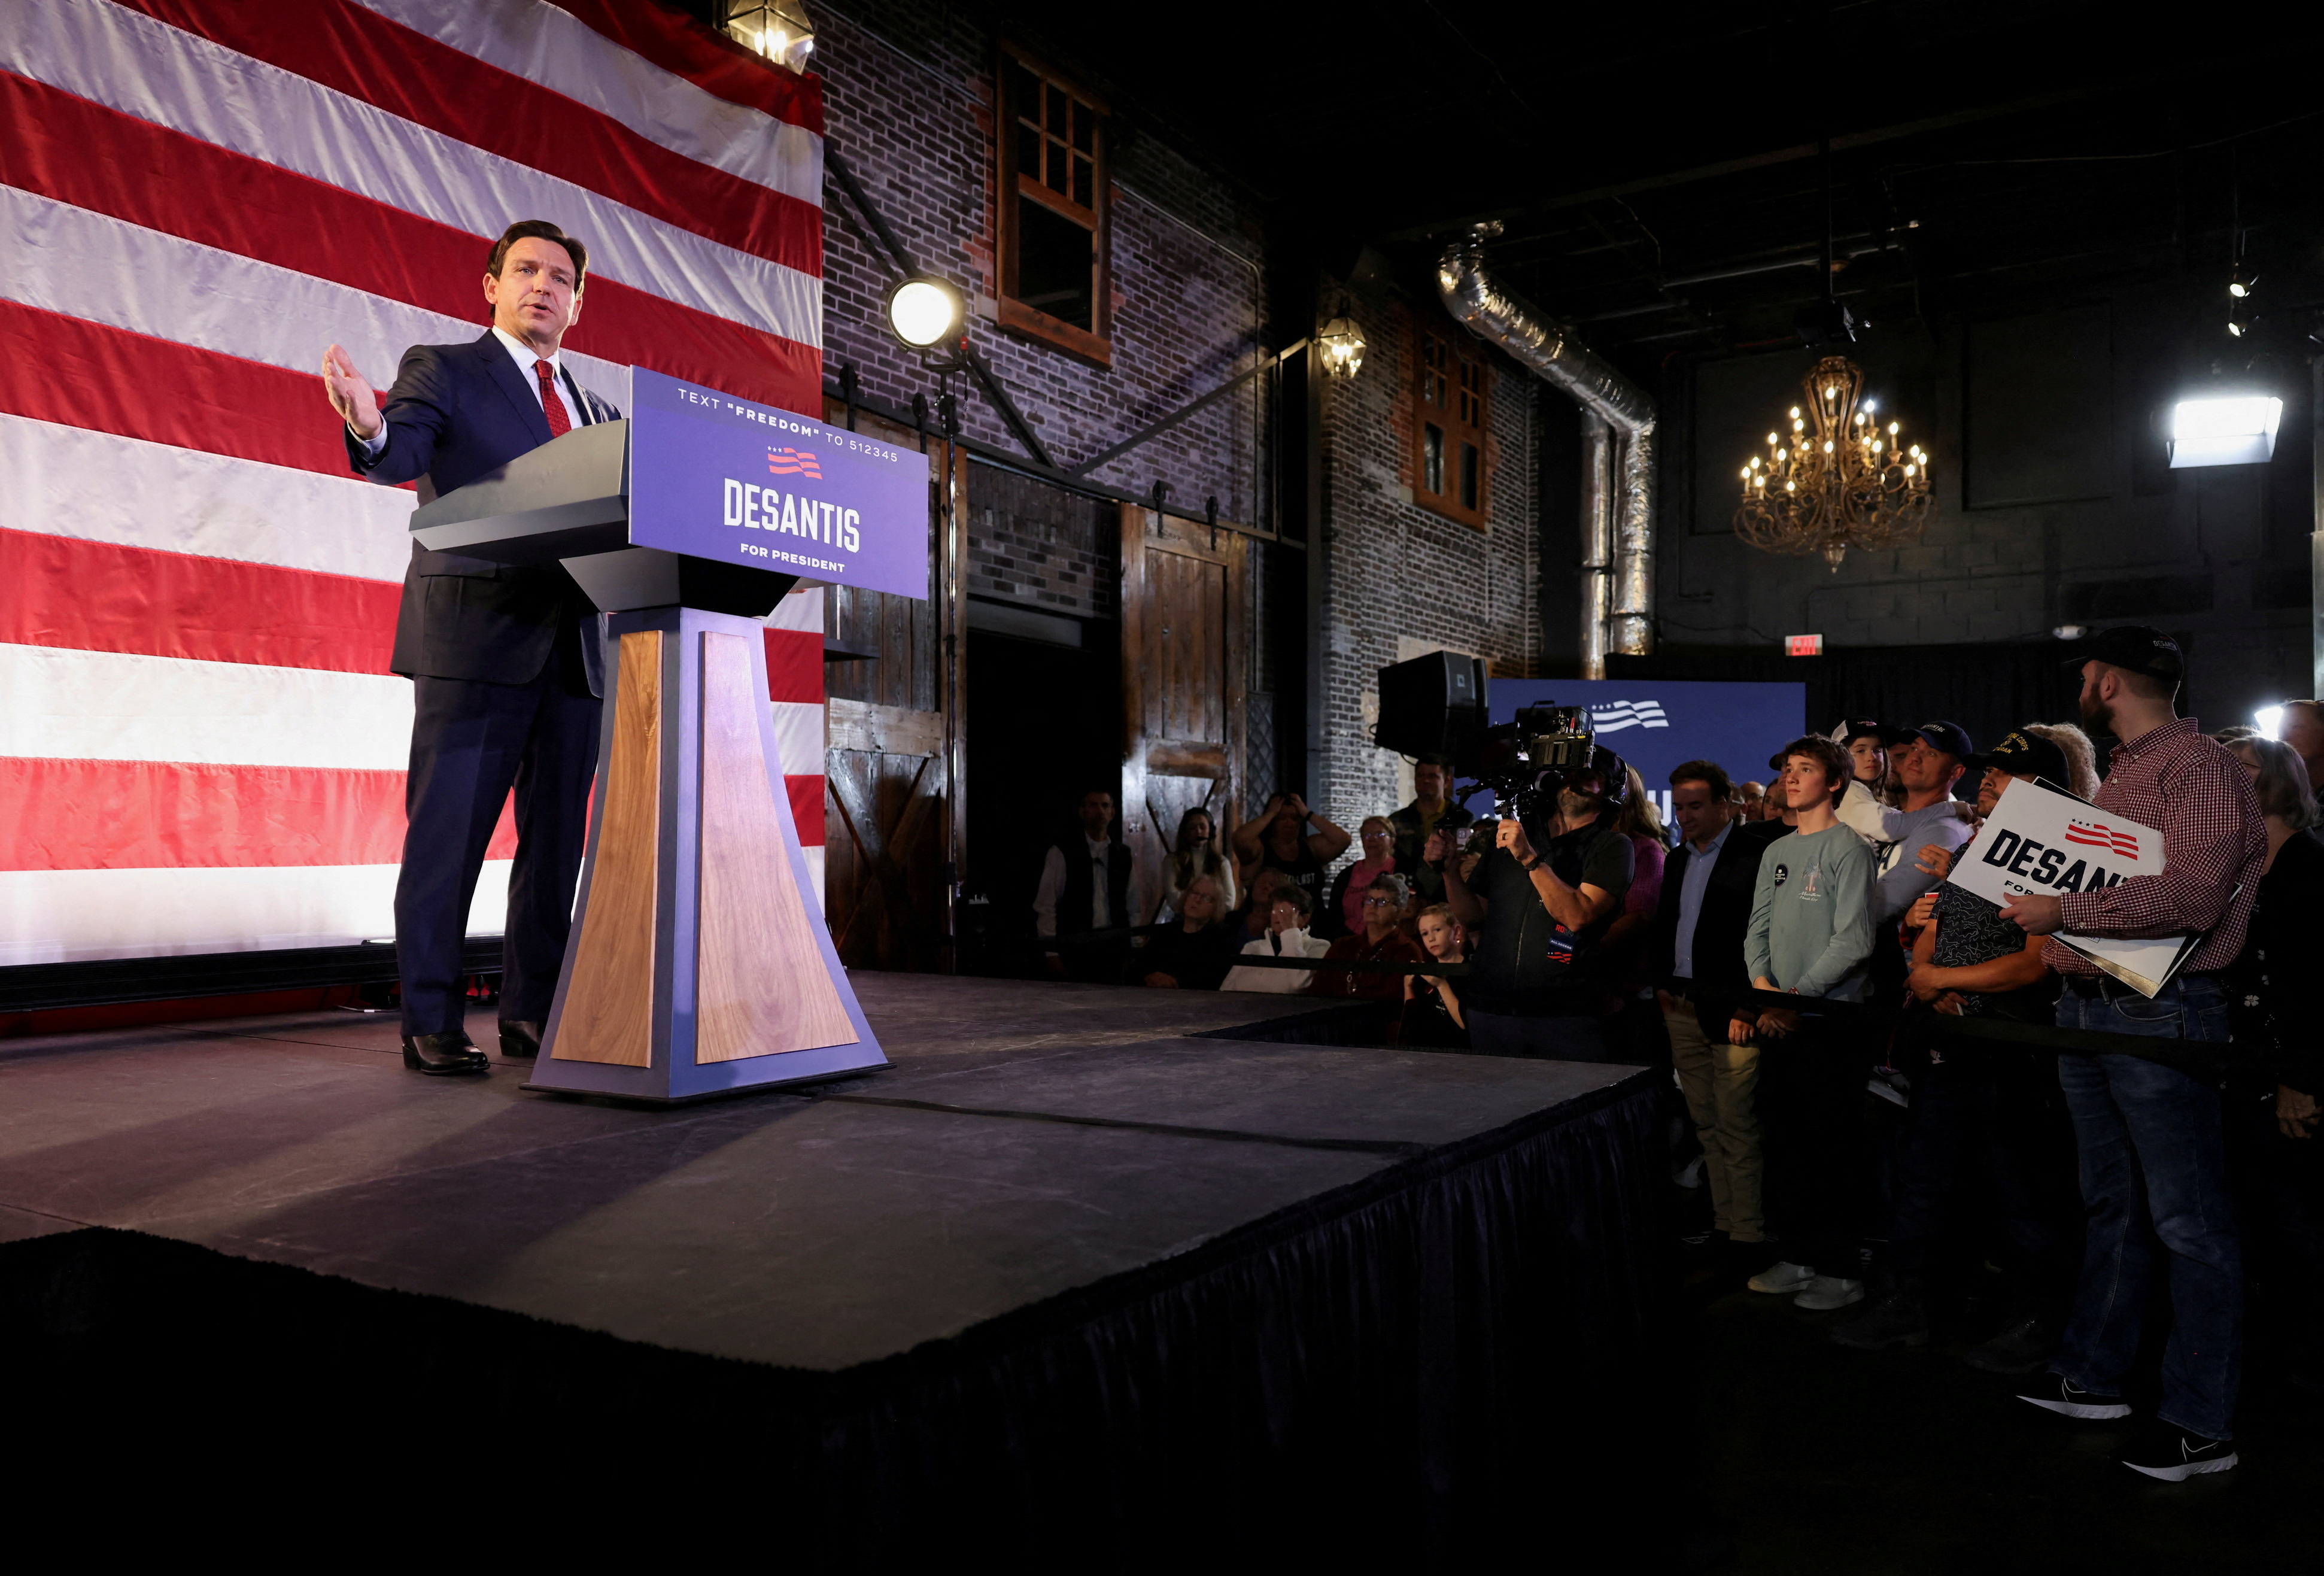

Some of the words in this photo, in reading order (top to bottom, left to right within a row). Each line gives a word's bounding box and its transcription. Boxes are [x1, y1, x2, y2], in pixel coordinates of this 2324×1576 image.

[678, 388, 720, 409] TEXT
[727, 402, 819, 438] "FREEDOM"
[825, 432, 843, 447] TO
[849, 440, 898, 462] 512345
[724, 478, 860, 554] DESANTIS
[740, 543, 768, 558] FOR
[771, 549, 845, 573] PRESIDENT
[1791, 636, 1818, 656] EXIT
[2016, 736, 2029, 751] CORPS
[1982, 828, 2128, 893] DESAN
[2004, 880, 2034, 895] FOR
